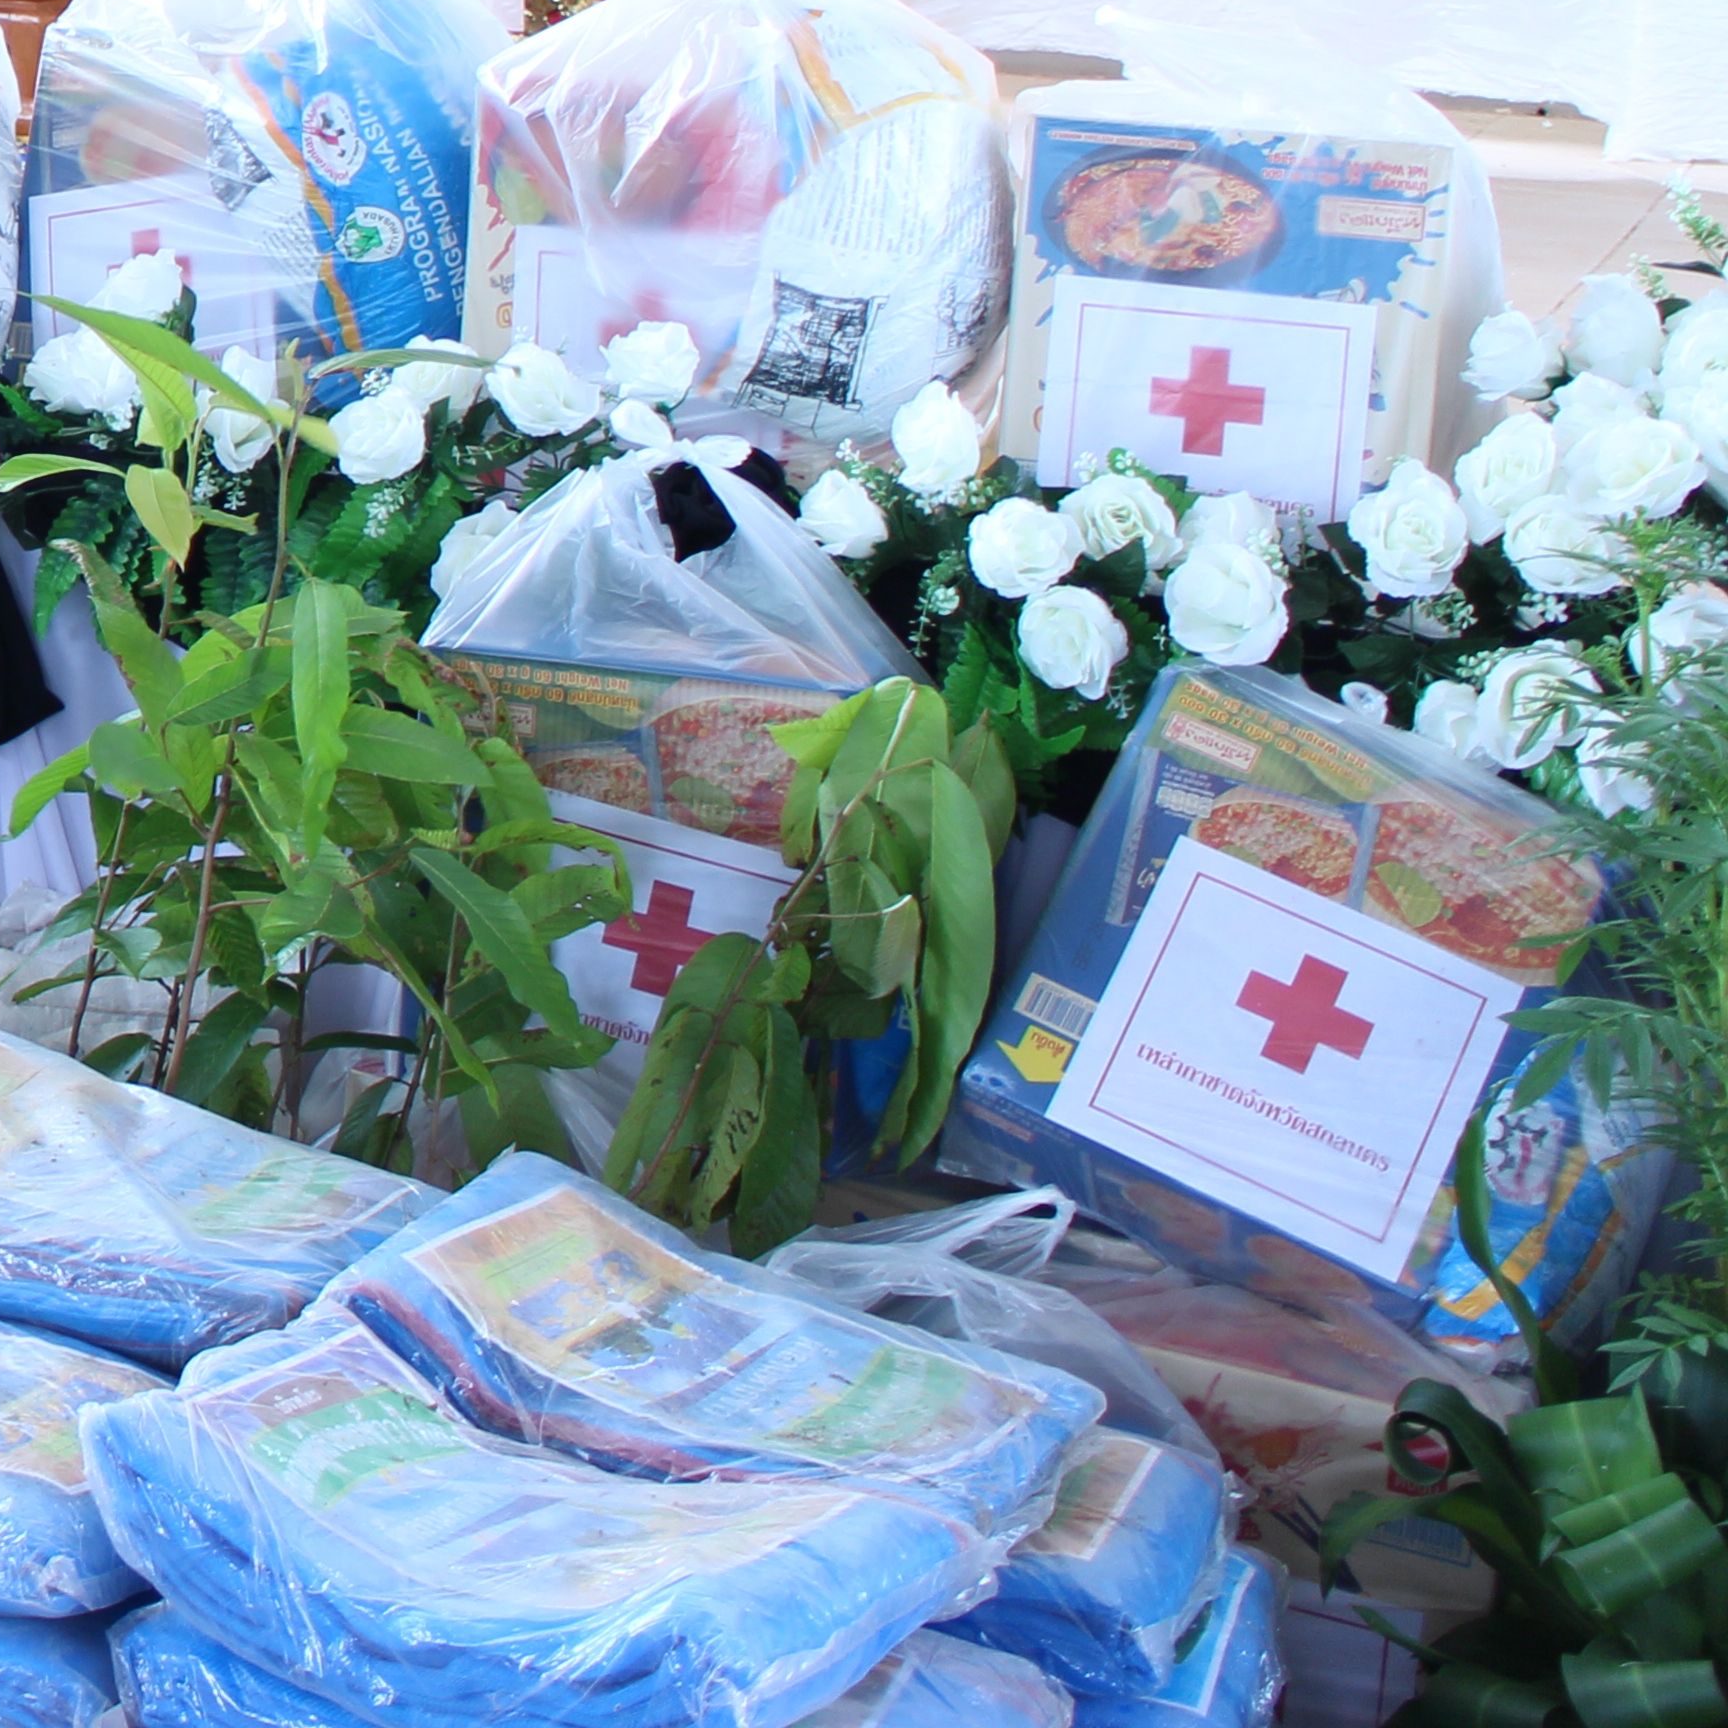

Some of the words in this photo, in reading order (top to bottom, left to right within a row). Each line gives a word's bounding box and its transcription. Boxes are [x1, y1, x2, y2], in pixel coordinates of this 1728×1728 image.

[1136, 1042, 1391, 1173] เหล่ากาชาดจังหวัดสกลนคร
